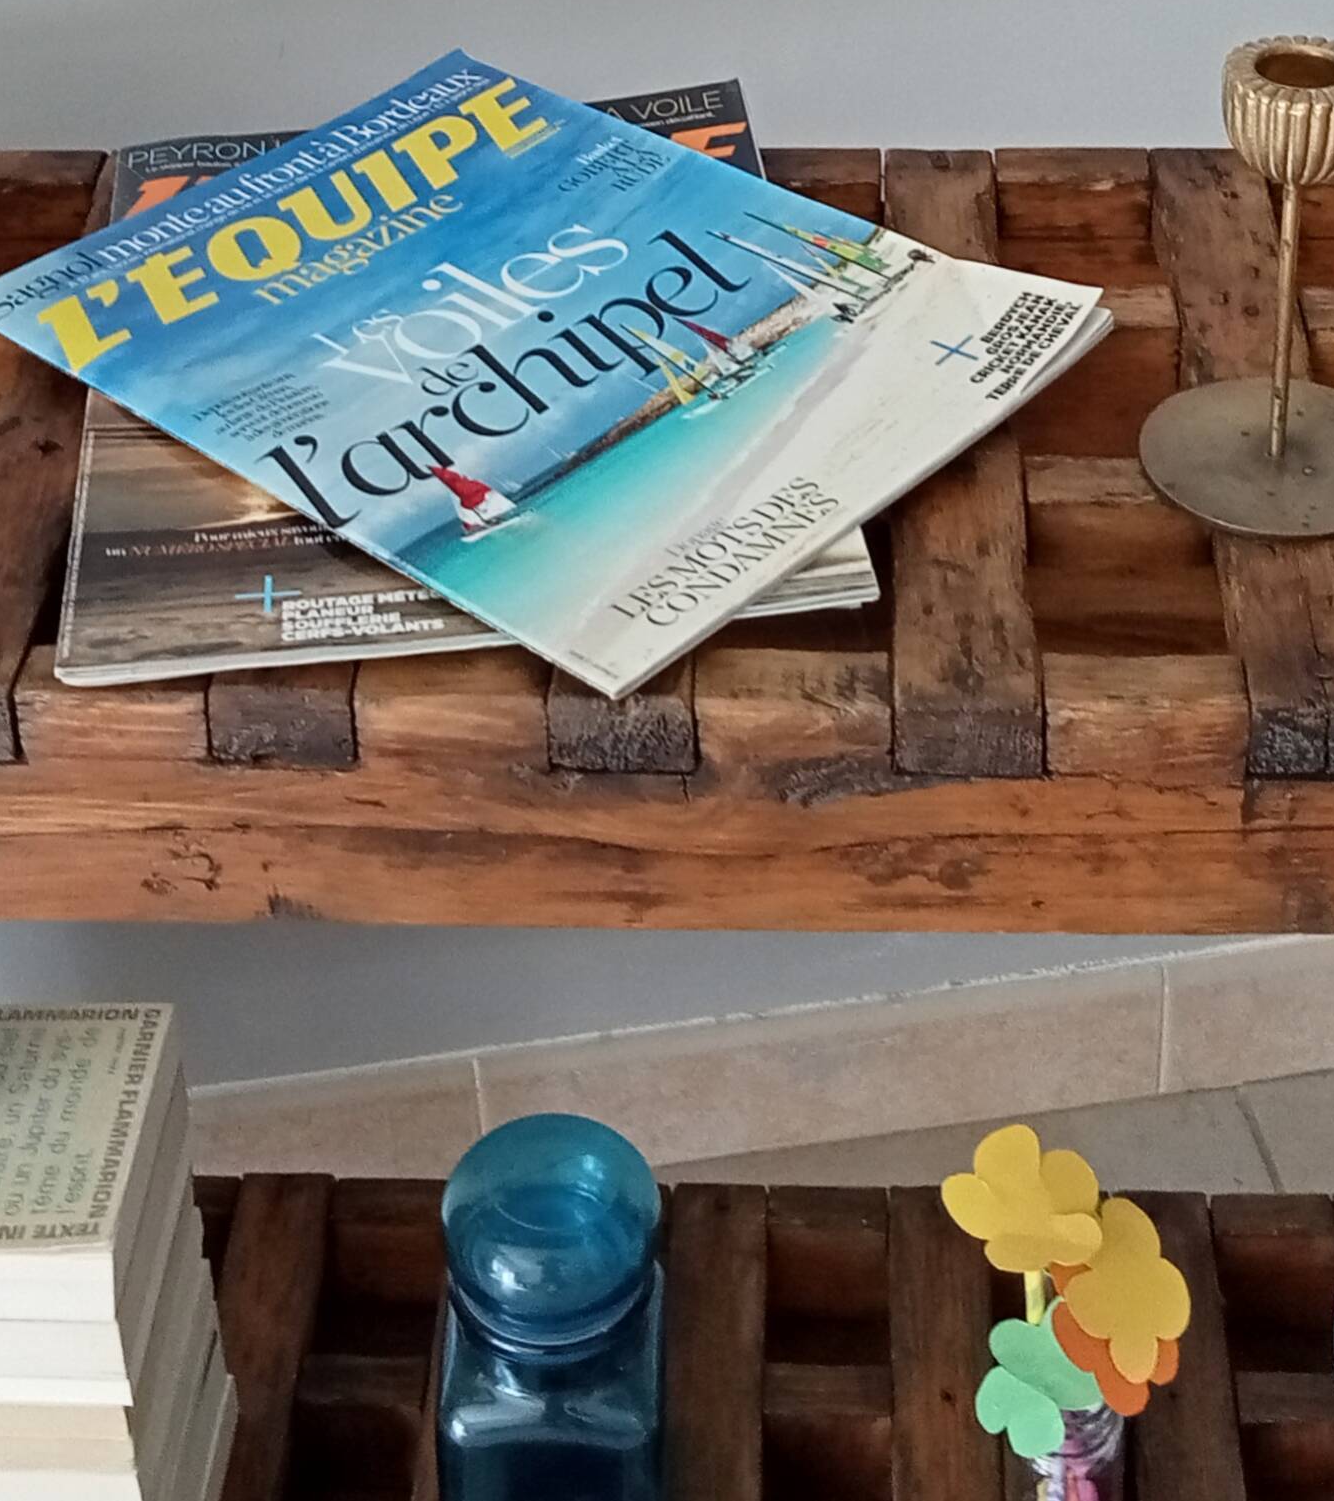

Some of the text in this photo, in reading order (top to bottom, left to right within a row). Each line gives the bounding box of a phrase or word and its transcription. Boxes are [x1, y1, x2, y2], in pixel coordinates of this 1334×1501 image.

[630, 90, 724, 120] VOILE
[96, 202, 211, 263] monte
[205, 186, 252, 214] au
[238, 147, 327, 197] front
[310, 138, 347, 157] à
[331, 68, 483, 148] Bordeaux
[127, 139, 266, 169] PEYRON
[255, 194, 464, 304] magazine
[319, 224, 630, 387] voiles
[980, 291, 1033, 344] BERDYCH
[311, 308, 404, 352] Les
[969, 297, 1058, 384] CRICKET KANAK
[985, 303, 1084, 401] TERRE DE CHEVAL
[254, 230, 751, 528] l'archipel
[419, 361, 479, 396] de
[611, 476, 820, 619] LES MOTS DES
[281, 593, 374, 611] ROUTAGE
[281, 604, 375, 621] PLANEUR
[281, 612, 401, 632] SOUFFLERIE
[281, 618, 445, 642] CERFS-VOLANTS
[40, 1068, 62, 1090] du
[49, 1131, 70, 1155] du
[60, 1058, 91, 1122] monde
[78, 1027, 101, 1047] de
[5, 1101, 26, 1125] un
[17, 1095, 53, 1156] Jupiter
[88, 1008, 162, 1219] GARNIER FLAMMARION
[13, 1162, 33, 1185] un
[32, 1221, 100, 1240] TEXTE
